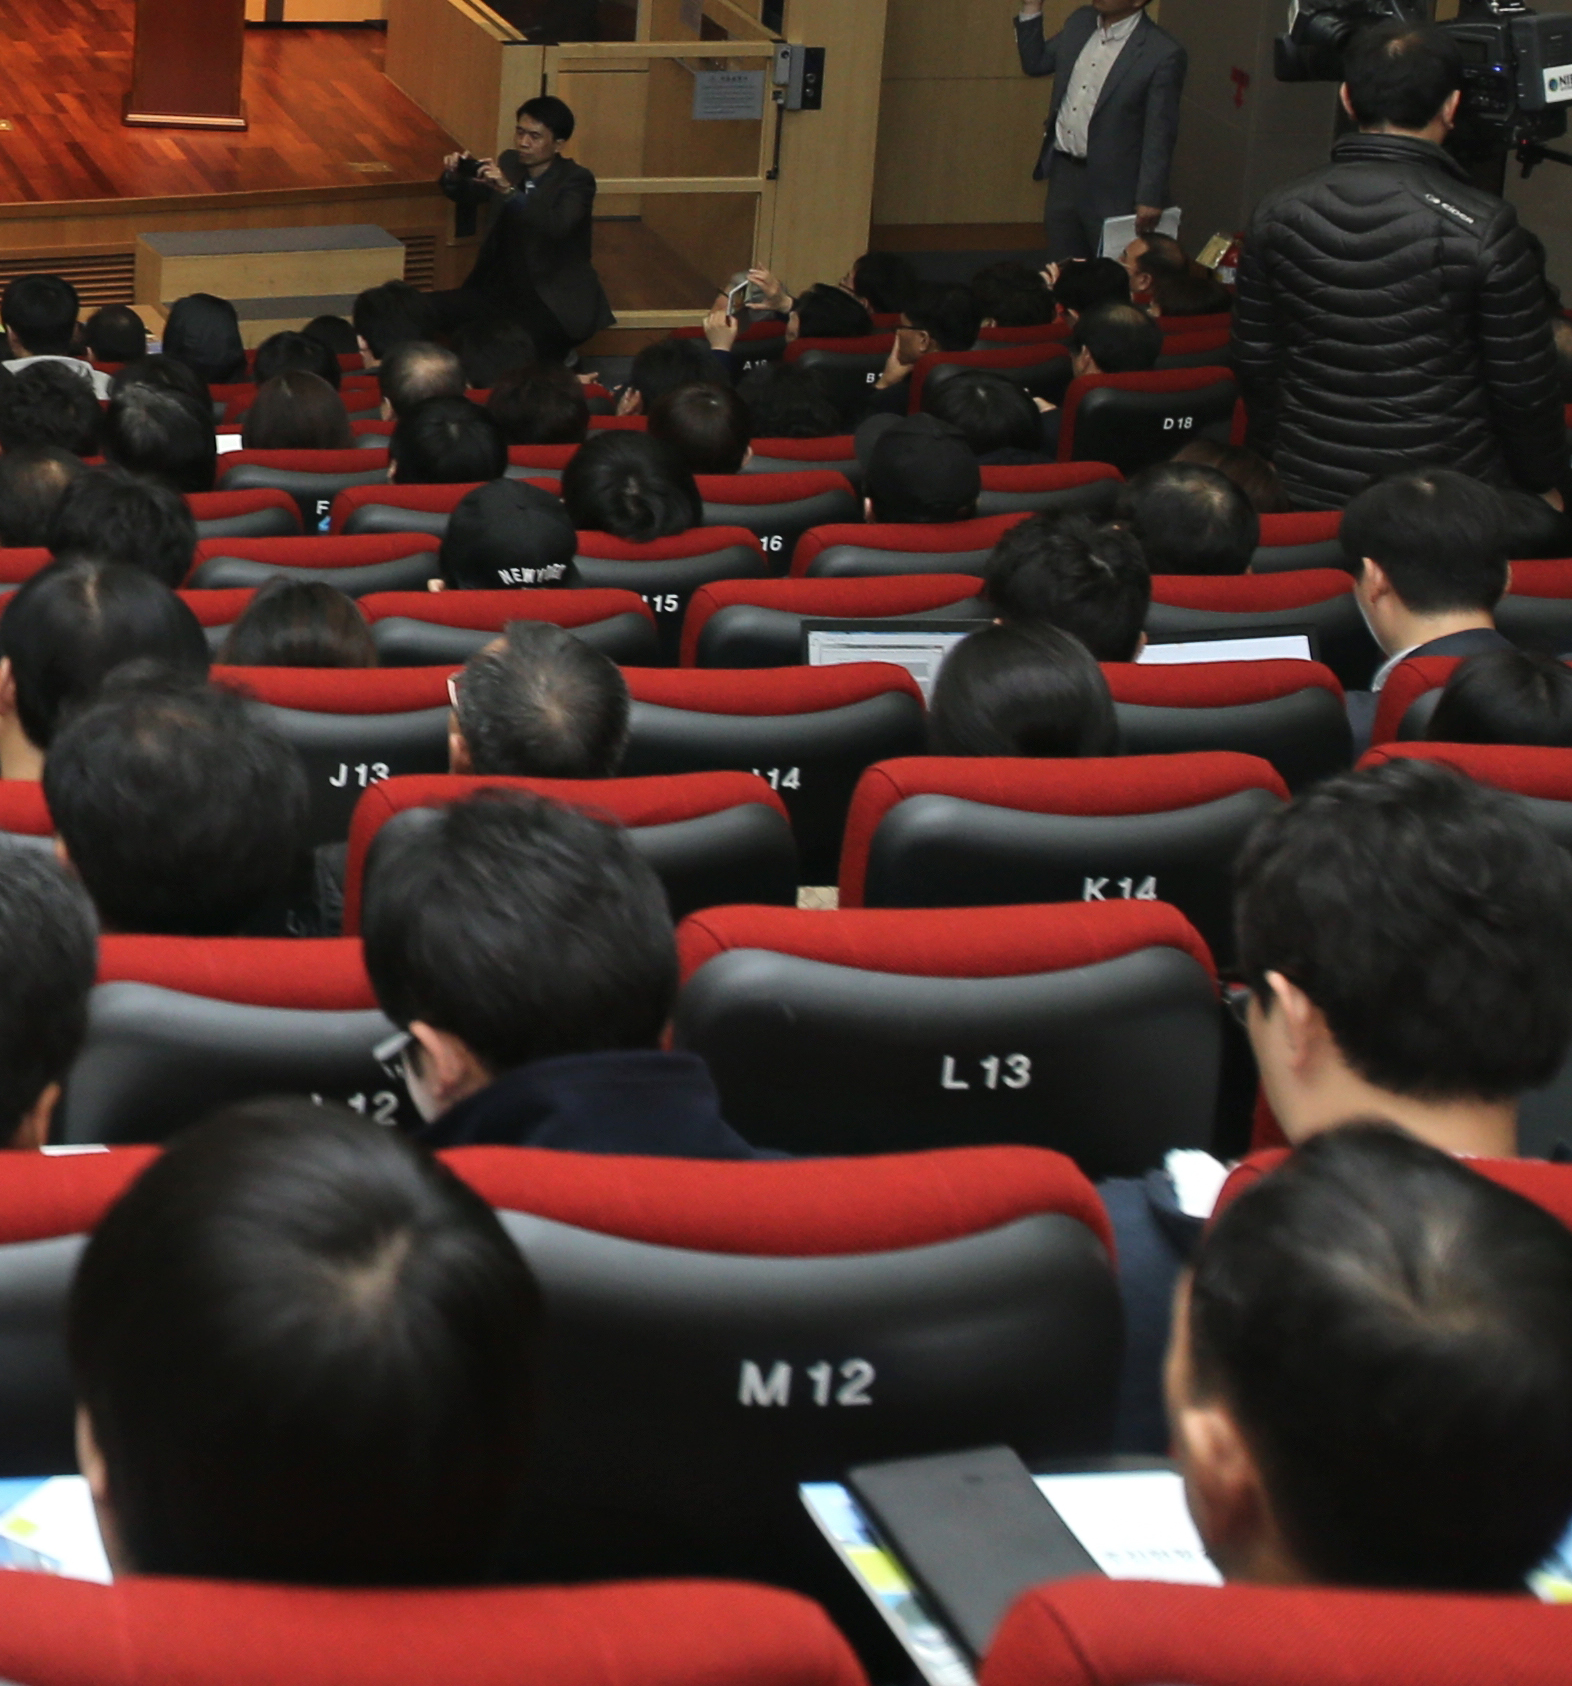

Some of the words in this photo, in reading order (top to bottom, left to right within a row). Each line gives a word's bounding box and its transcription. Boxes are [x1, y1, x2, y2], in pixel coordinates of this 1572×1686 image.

[1177, 416, 1194, 430] 18
[760, 535, 783, 552] 16
[653, 594, 679, 613] 15
[329, 763, 348, 787] J
[354, 762, 390, 787] 13
[767, 767, 801, 791] 14
[1083, 876, 1111, 902] K
[1117, 875, 1159, 901] 14
[941, 1055, 970, 1090] L
[979, 1053, 1032, 1090] 13
[739, 1359, 793, 1407] M
[807, 1358, 875, 1407] 12
